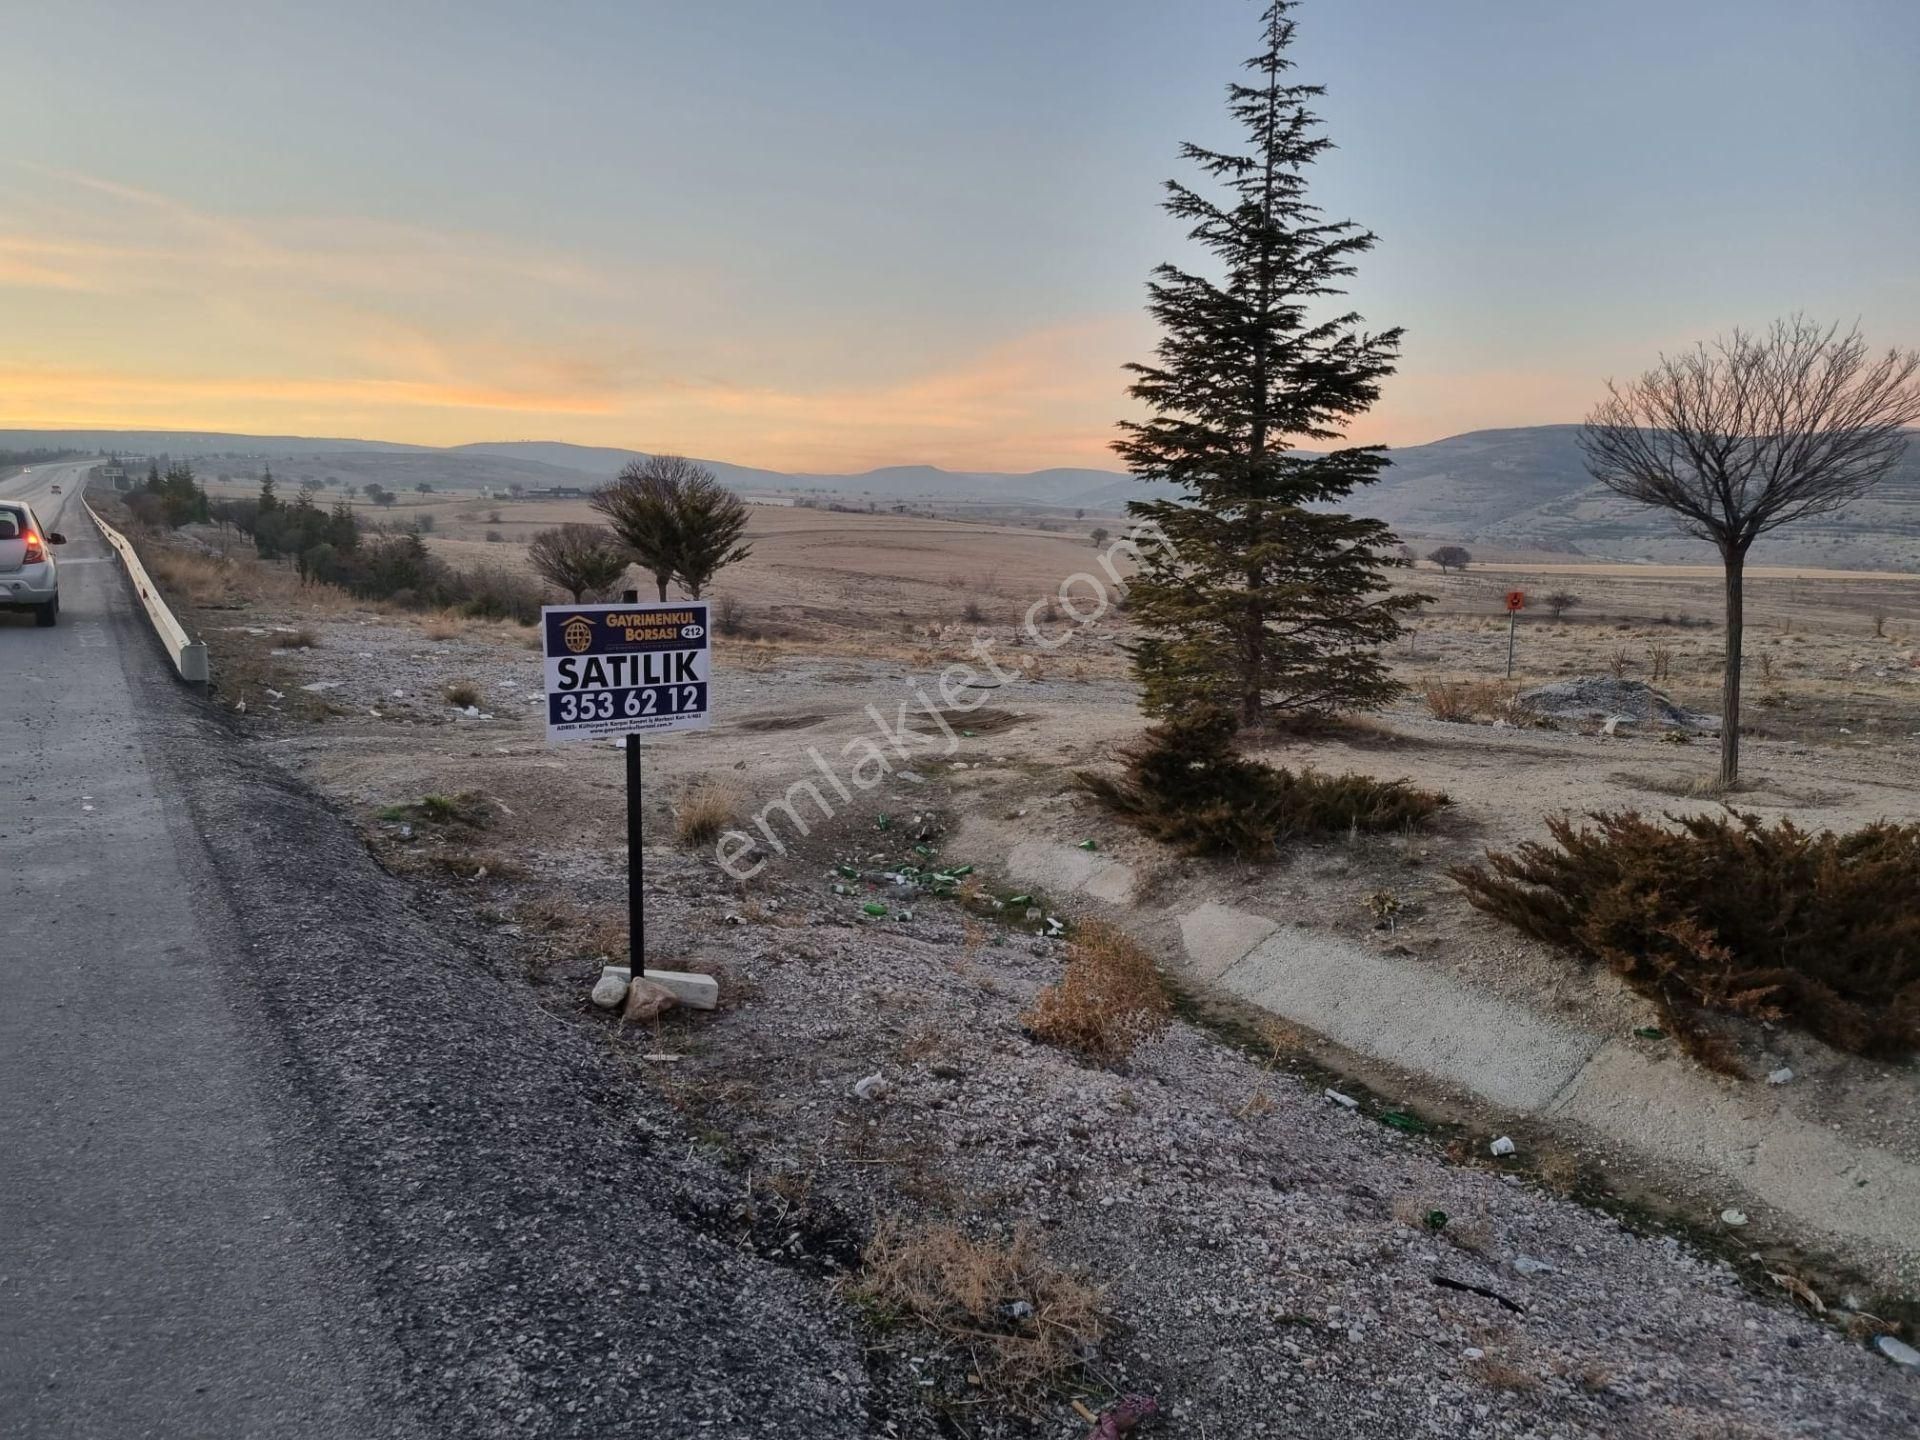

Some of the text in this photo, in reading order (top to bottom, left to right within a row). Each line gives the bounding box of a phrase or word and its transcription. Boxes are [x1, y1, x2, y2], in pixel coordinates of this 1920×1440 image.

[606, 612, 696, 628] GAYRIMENKUL
[625, 628, 677, 641] BORSASI
[684, 627, 701, 636] 212
[558, 651, 699, 691] SATILIK
[560, 685, 698, 721] 353 62 12
